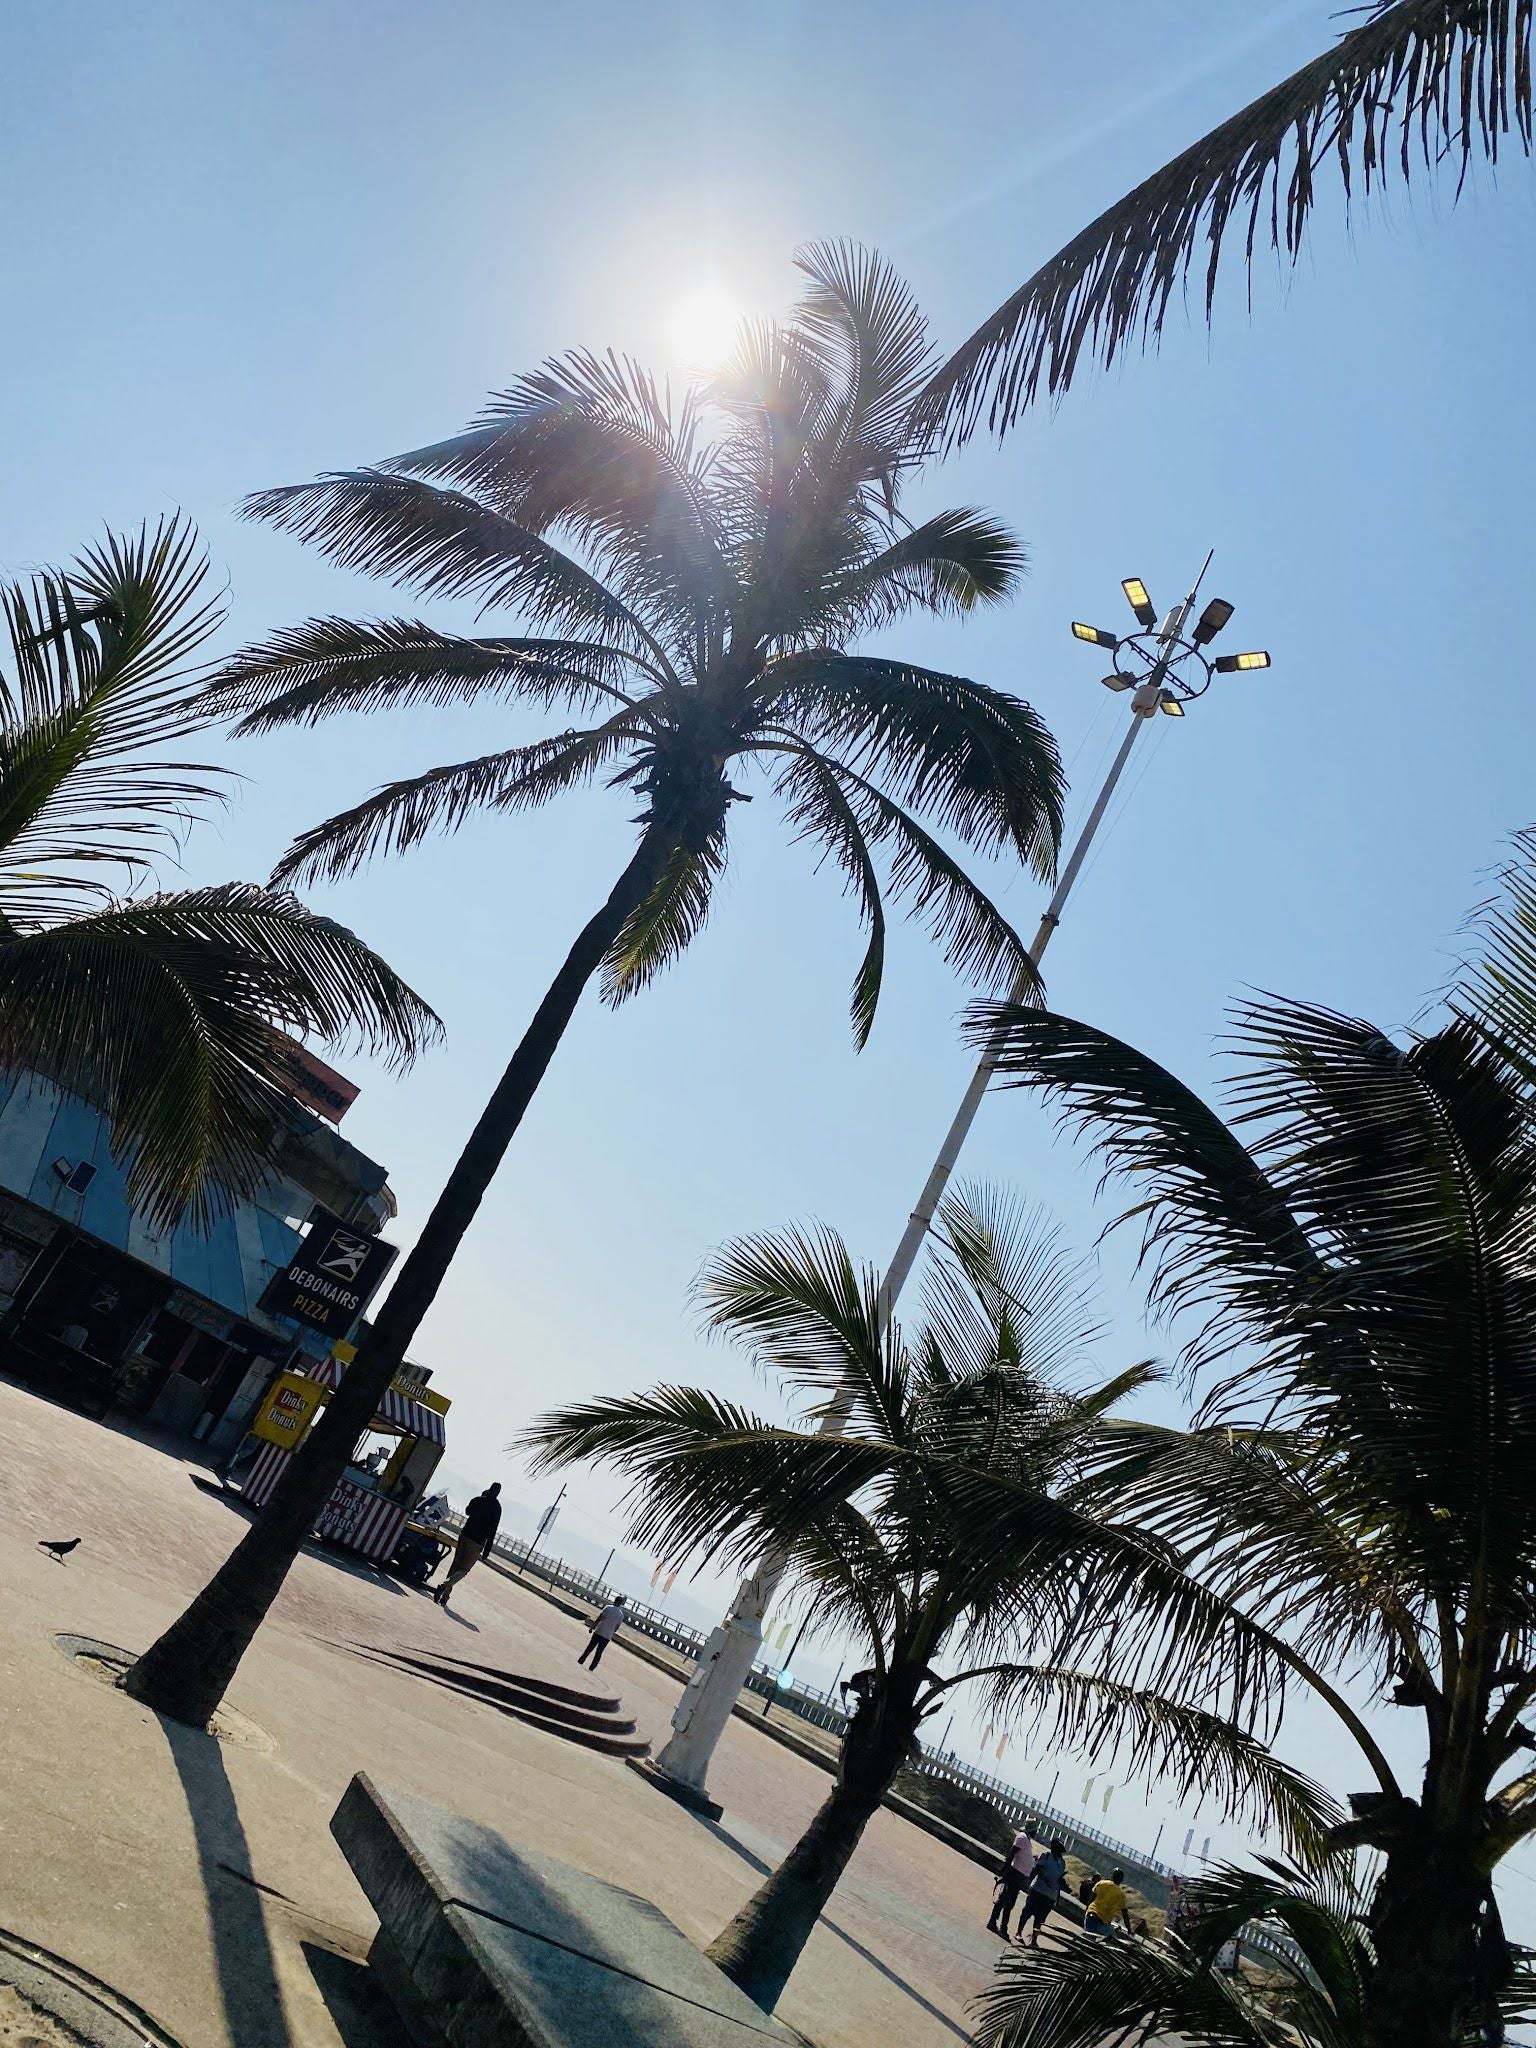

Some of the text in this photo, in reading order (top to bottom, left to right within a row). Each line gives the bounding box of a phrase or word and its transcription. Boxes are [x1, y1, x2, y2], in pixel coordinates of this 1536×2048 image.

[289, 1267, 359, 1310] DEBONAIRS
[293, 1294, 330, 1323] PIZZA
[397, 1375, 430, 1401] Donuts
[280, 1390, 307, 1415] Dinky
[267, 1406, 297, 1430] Donuts
[330, 1487, 366, 1514] Dinky
